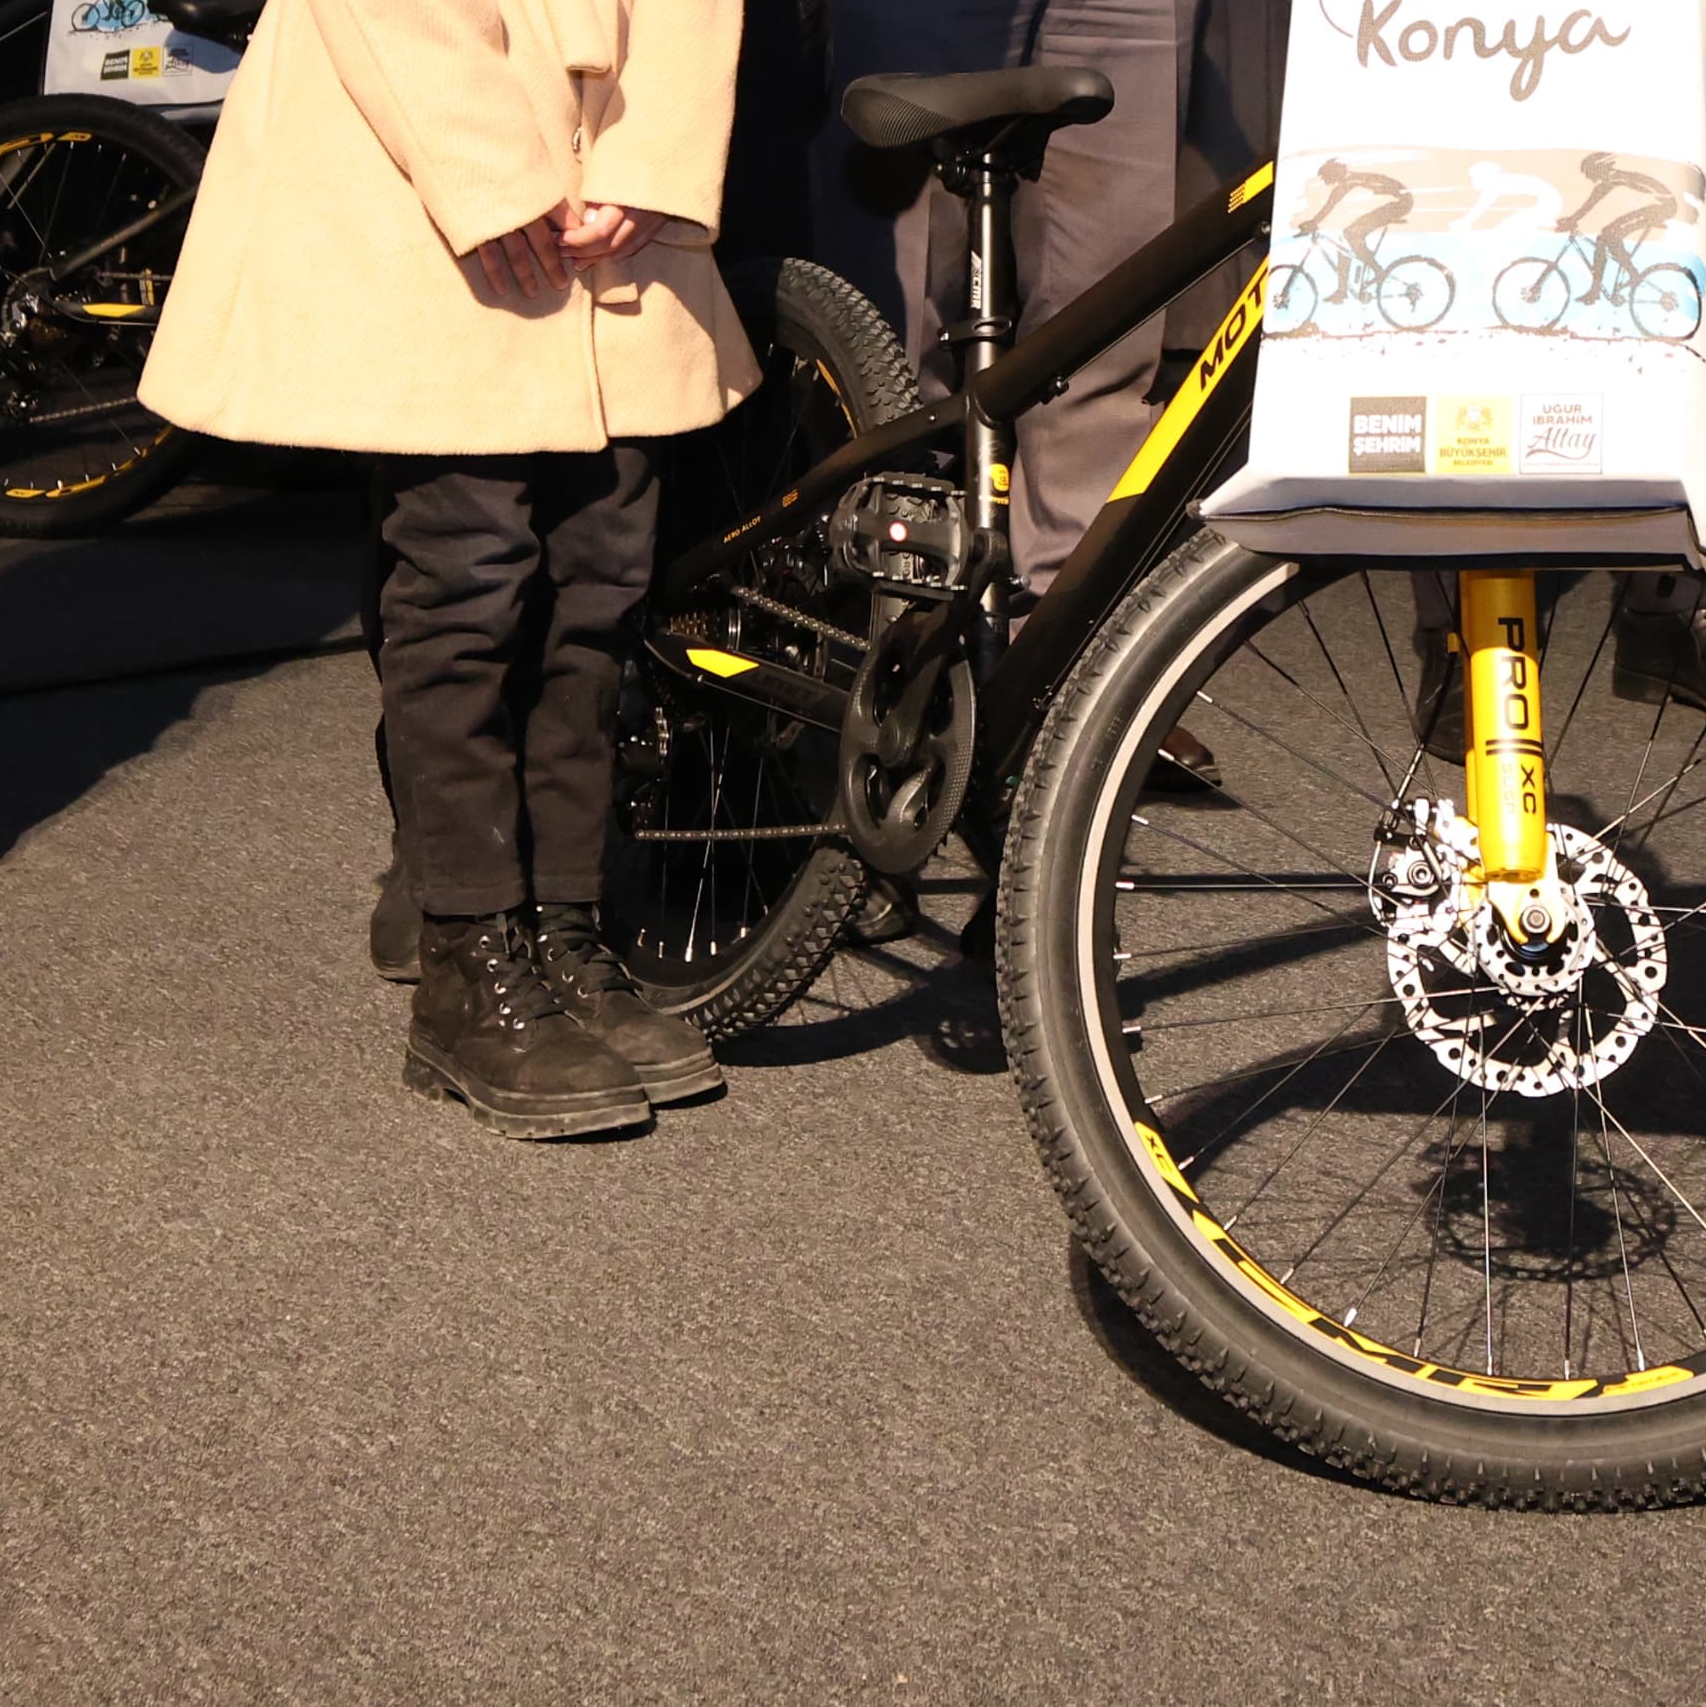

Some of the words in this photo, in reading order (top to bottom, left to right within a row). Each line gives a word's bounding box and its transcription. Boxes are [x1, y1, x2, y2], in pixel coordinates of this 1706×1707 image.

[1542, 403, 1583, 414] UĞUR
[1353, 414, 1422, 434] BENİM
[1352, 435, 1421, 456] ŞEHRİM
[1456, 437, 1490, 445] KONYA
[1497, 616, 1530, 731] PRO
[1520, 763, 1538, 815] XC
